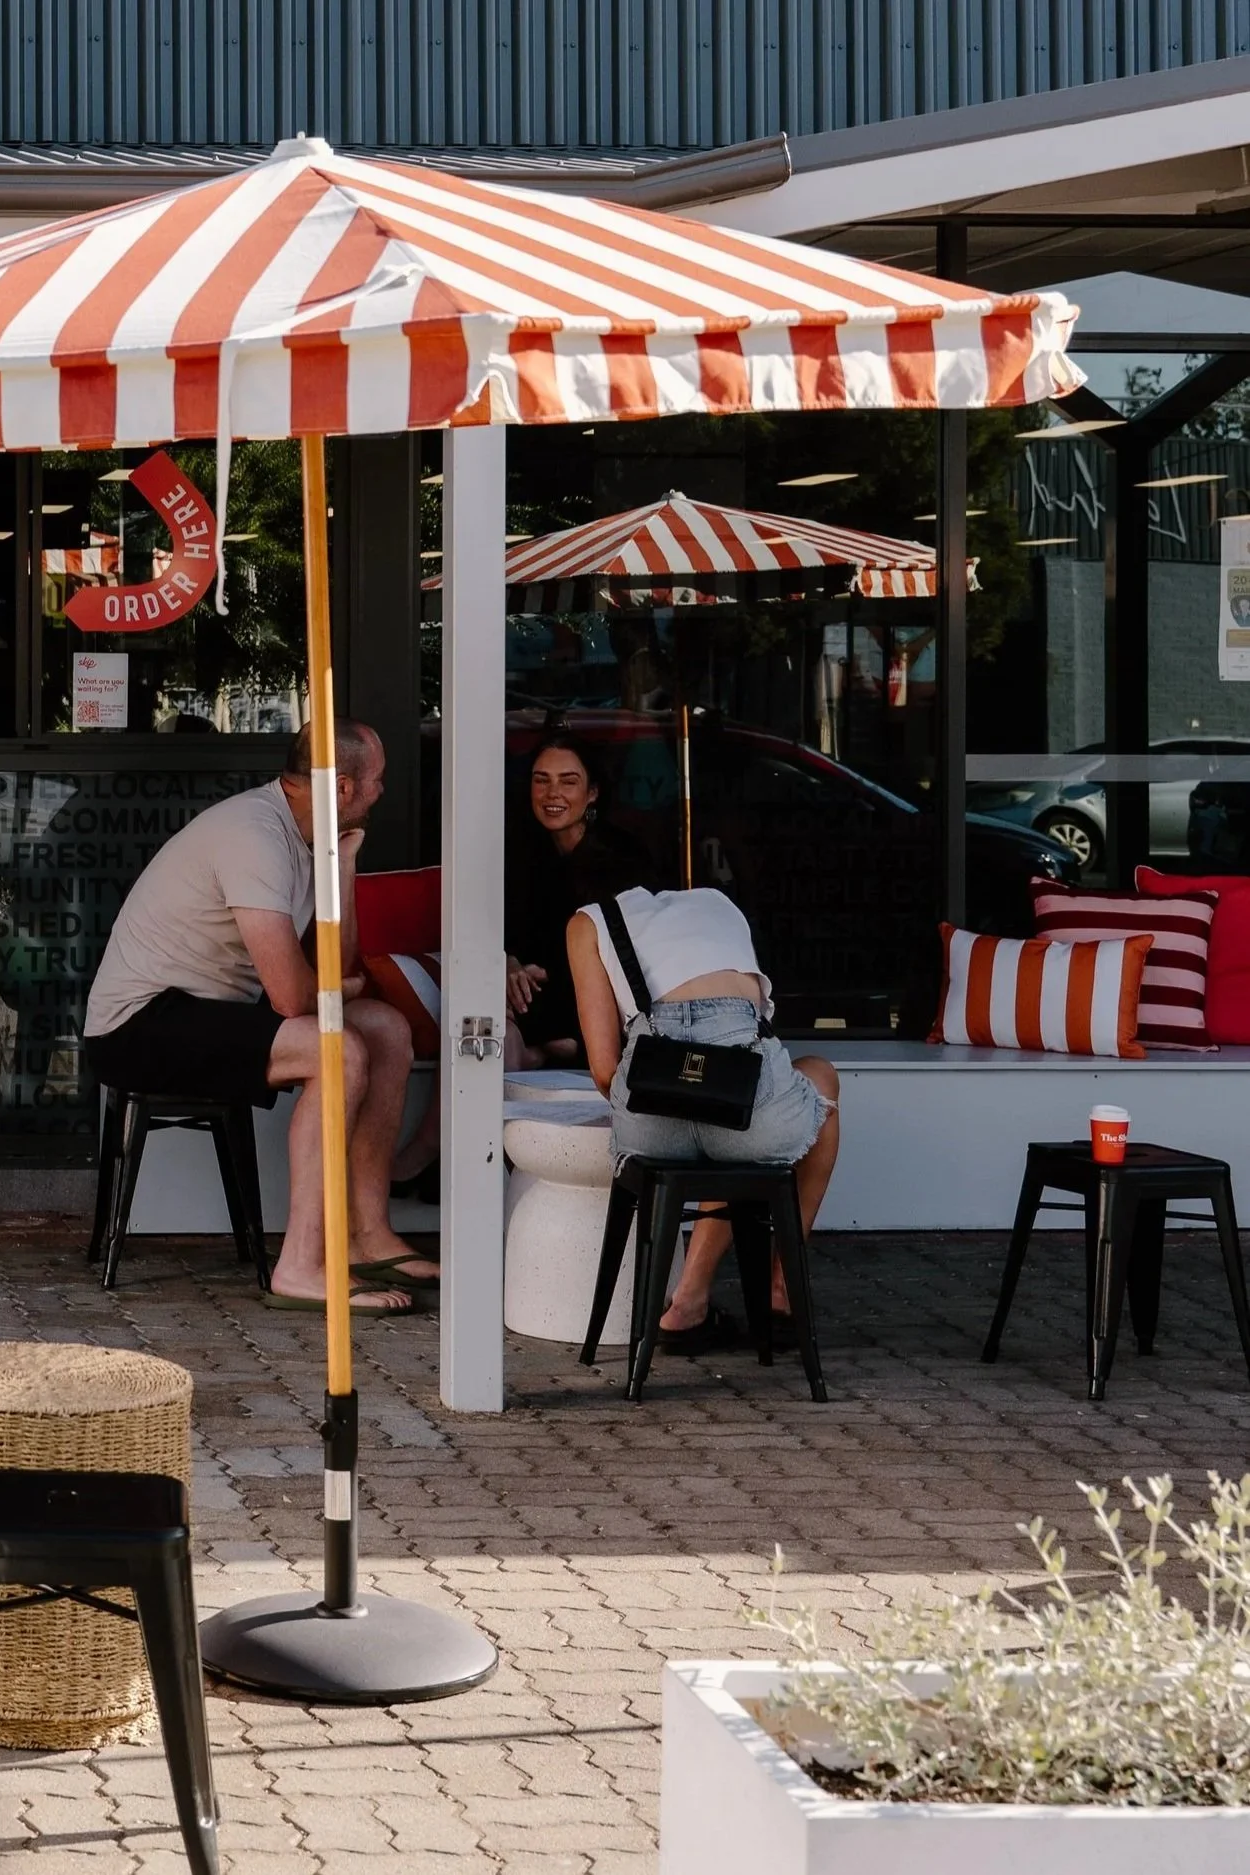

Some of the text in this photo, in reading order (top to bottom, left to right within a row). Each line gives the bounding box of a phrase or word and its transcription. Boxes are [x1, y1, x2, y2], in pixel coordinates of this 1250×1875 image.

[104, 483, 211, 623] ORDER HERE
[77, 677, 98, 685] What
[111, 679, 125, 687] you
[77, 685, 103, 693] waiting
[1100, 1132, 1118, 1142] The
